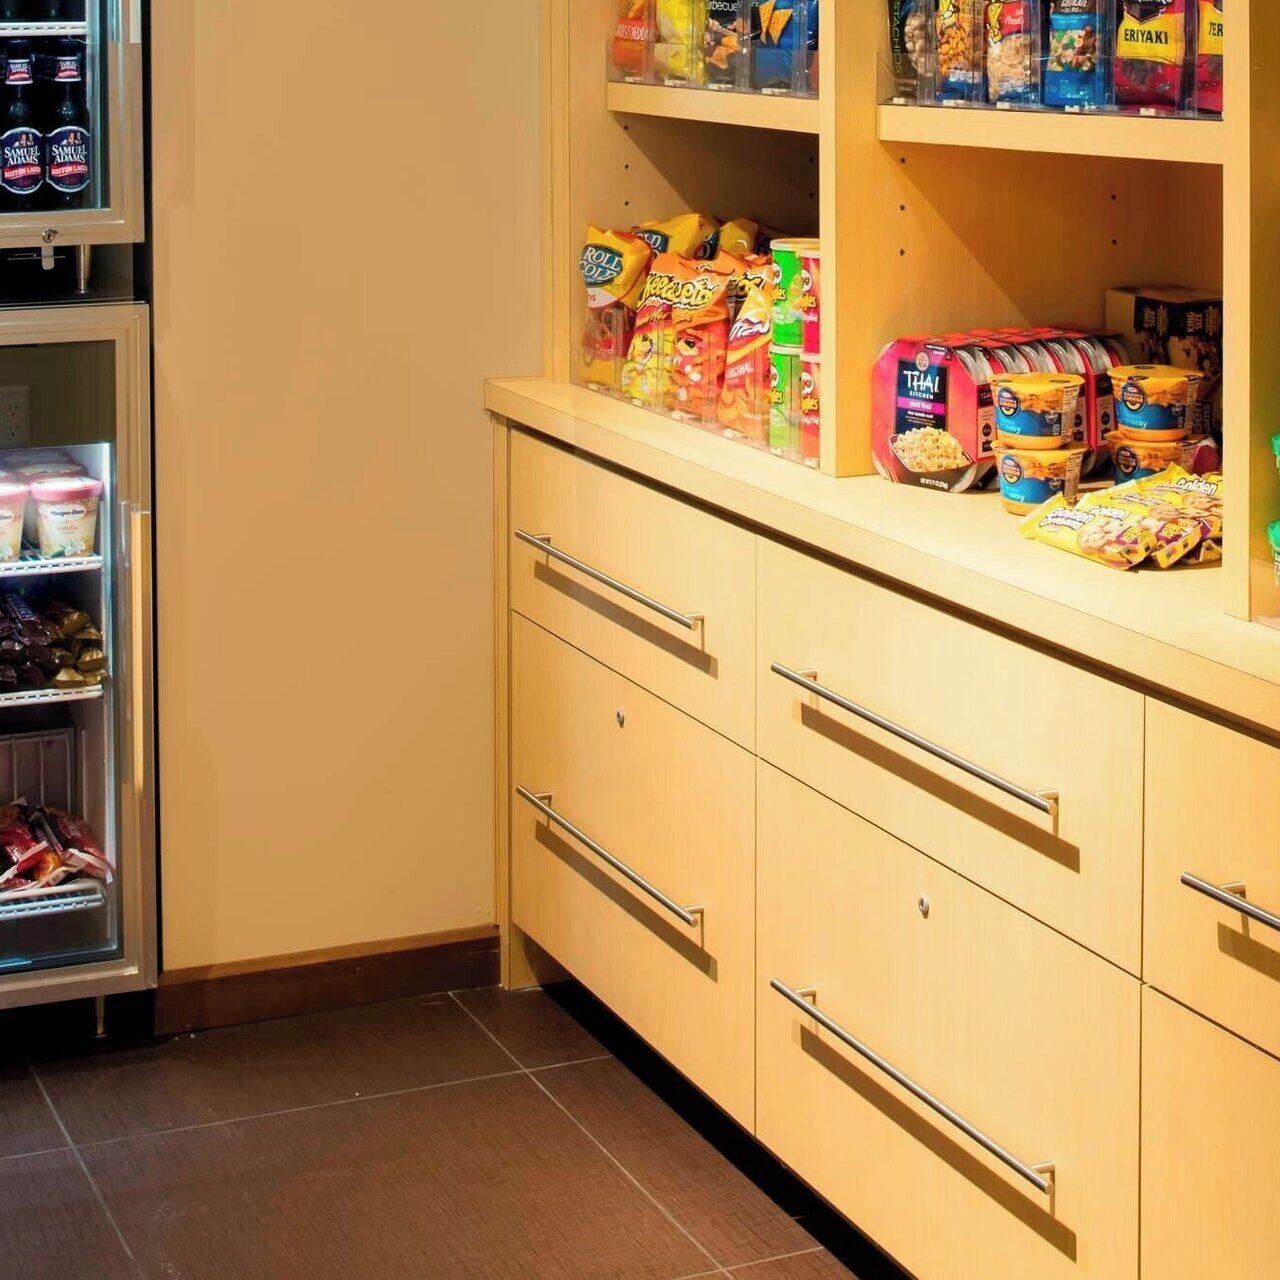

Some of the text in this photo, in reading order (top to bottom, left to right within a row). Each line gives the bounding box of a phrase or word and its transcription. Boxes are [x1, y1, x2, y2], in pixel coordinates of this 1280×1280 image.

[1124, 28, 1169, 45] ERIYAKI
[4, 146, 41, 159] SAMUEL
[51, 144, 87, 156] SAMUEL
[7, 154, 39, 167] ADAMS
[54, 153, 86, 164] ADAMS
[583, 246, 623, 271] ROLD
[903, 371, 940, 394] THAI
[909, 391, 934, 400] KITCHEN
[1177, 477, 1218, 495] Golden
